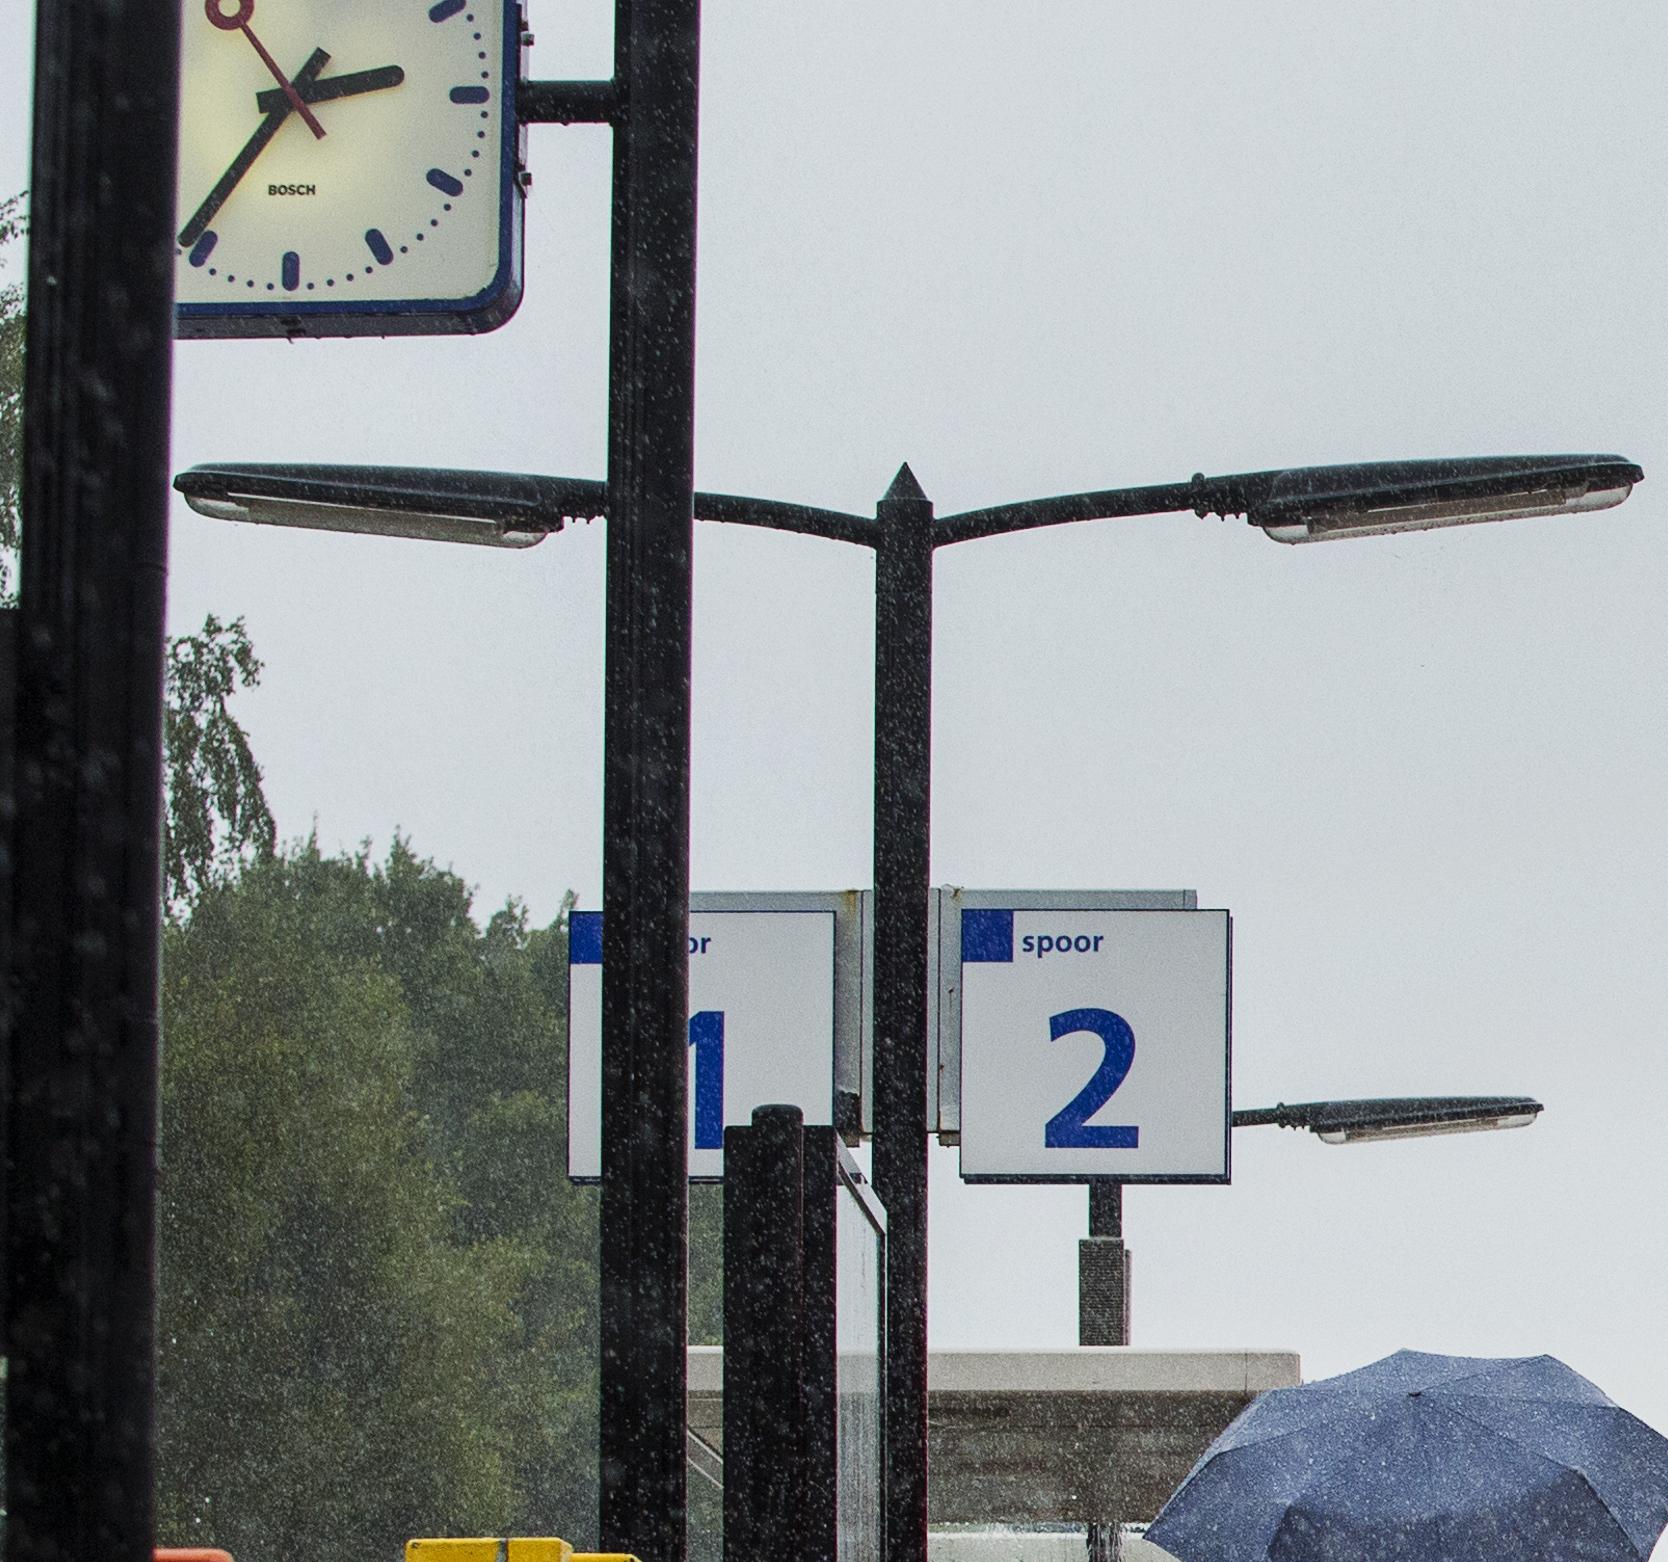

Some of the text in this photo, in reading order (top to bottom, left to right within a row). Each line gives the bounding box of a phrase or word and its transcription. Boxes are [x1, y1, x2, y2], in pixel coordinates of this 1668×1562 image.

[268, 184, 317, 196] BOSCH
[1022, 935, 1104, 958] spoor
[688, 1010, 724, 1149] 1
[1045, 1008, 1139, 1149] 2
